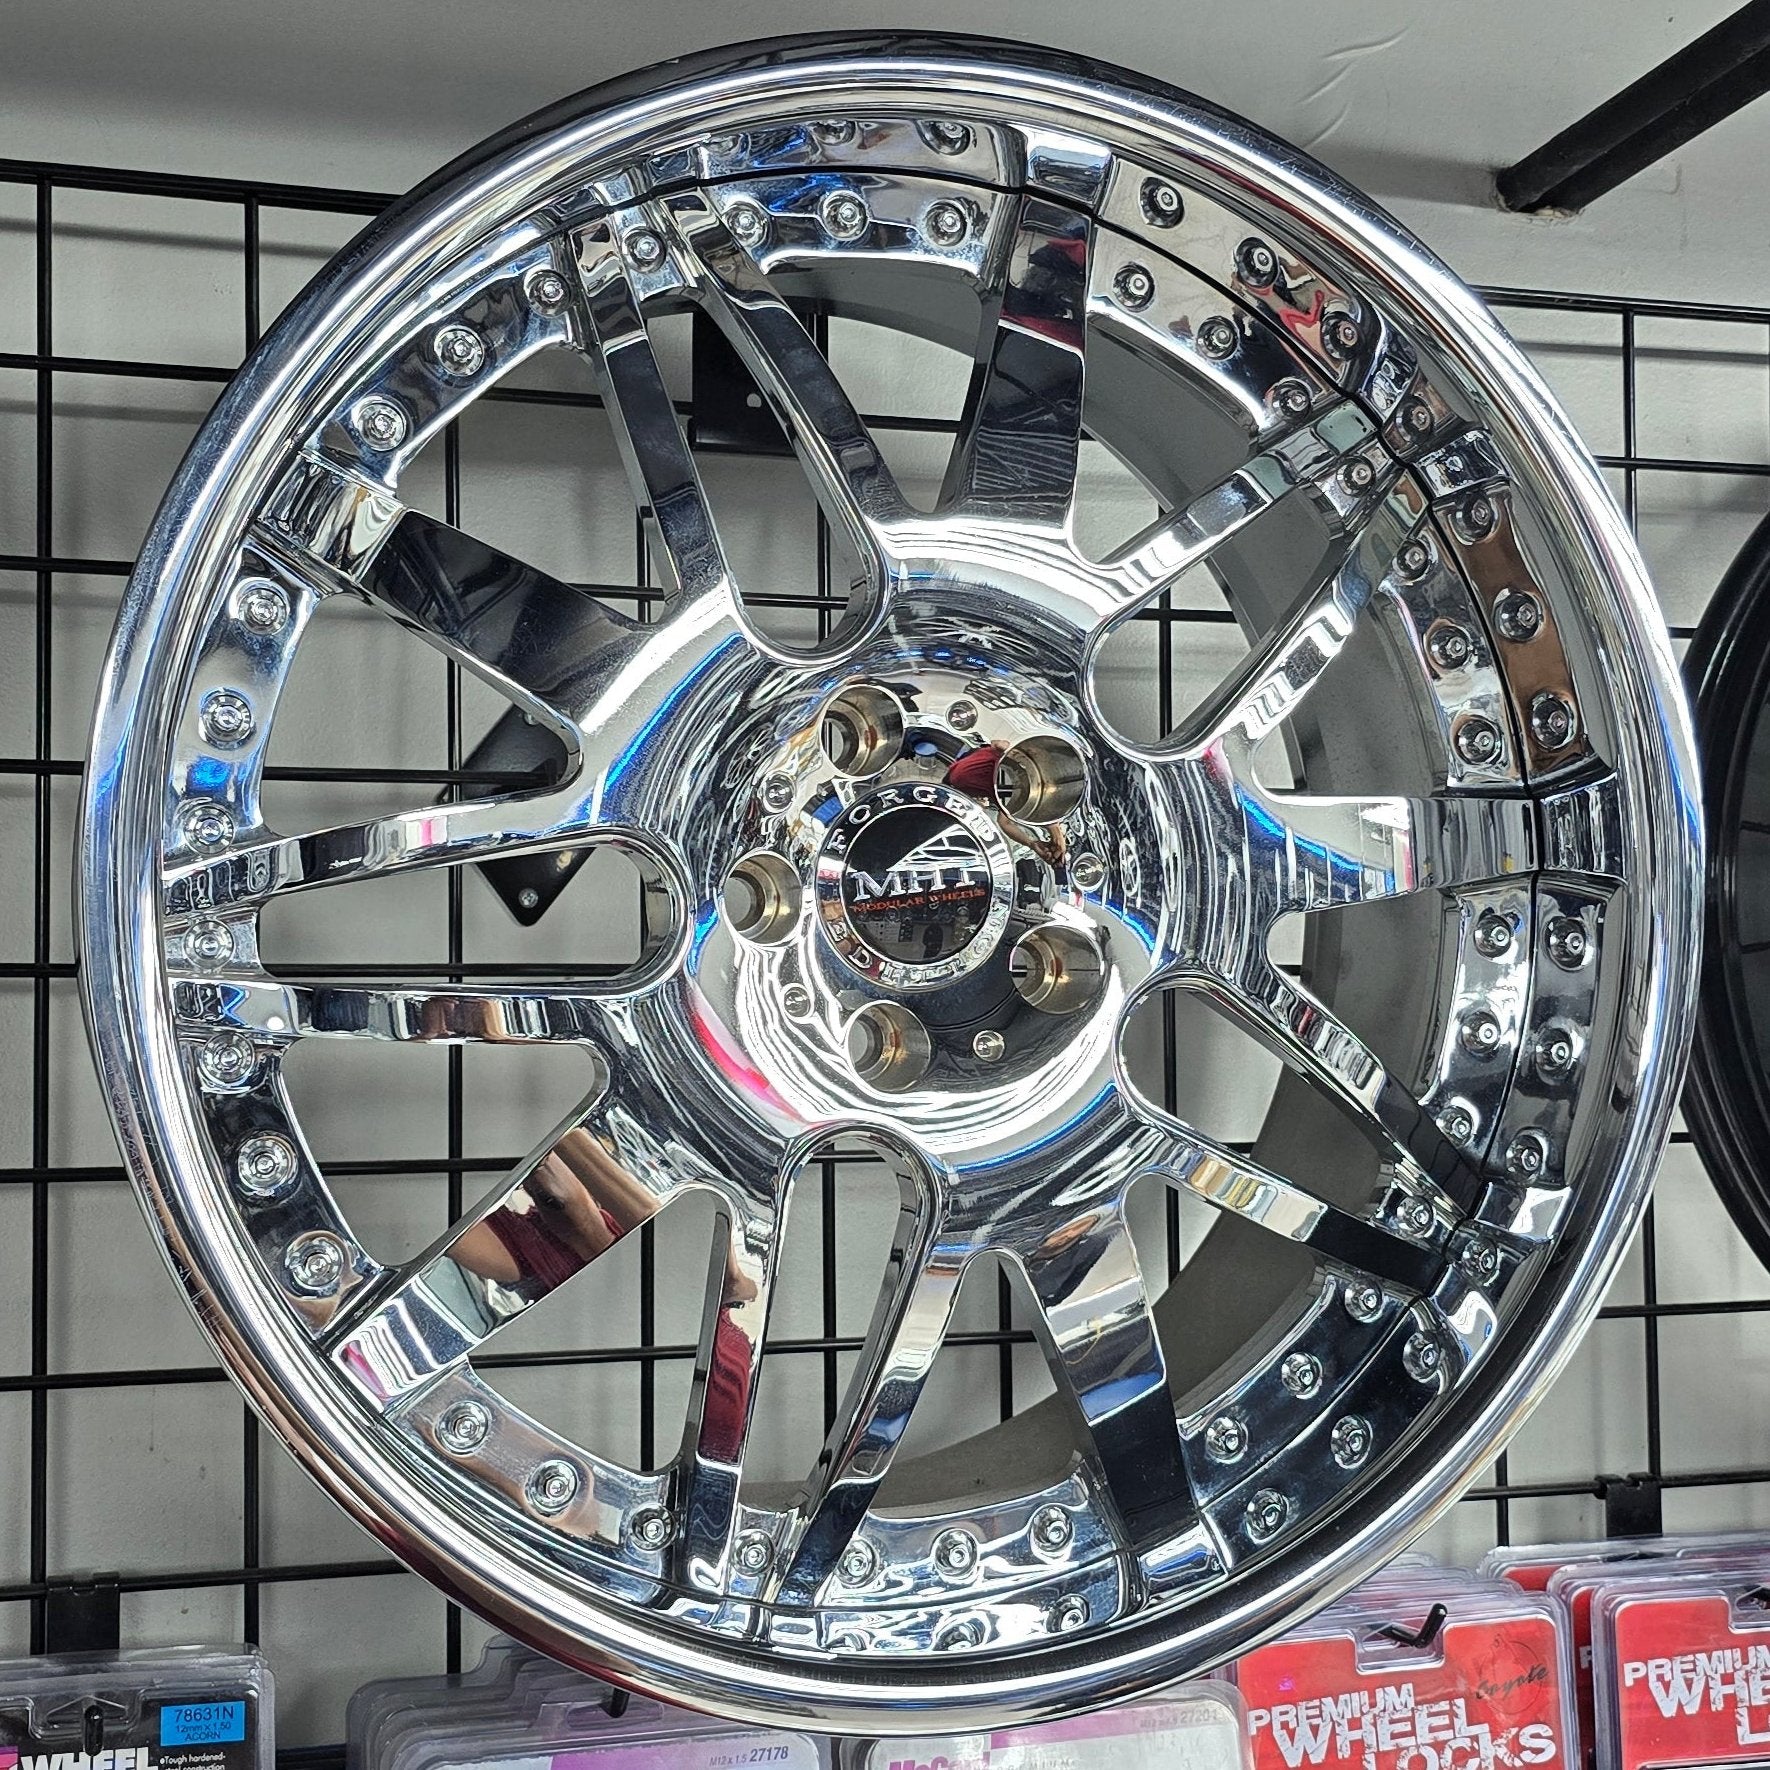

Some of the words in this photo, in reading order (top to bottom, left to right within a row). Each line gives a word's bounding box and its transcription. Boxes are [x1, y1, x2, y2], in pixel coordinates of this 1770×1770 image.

[827, 786, 996, 854] FORGED
[849, 867, 983, 901] MHT
[850, 895, 924, 914] MODULAR
[928, 888, 986, 904] WHEELS
[1475, 1662, 1549, 1701] Coyote
[175, 1707, 234, 1723] 78631N
[1247, 1683, 1415, 1736] PREMIUM
[176, 1724, 202, 1734] 12mm
[213, 1722, 231, 1731] 1.50
[185, 1731, 221, 1741] ACORN
[1273, 1698, 1491, 1768] WHEEL
[164, 1754, 188, 1765] Tough
[750, 1746, 789, 1762] 27178
